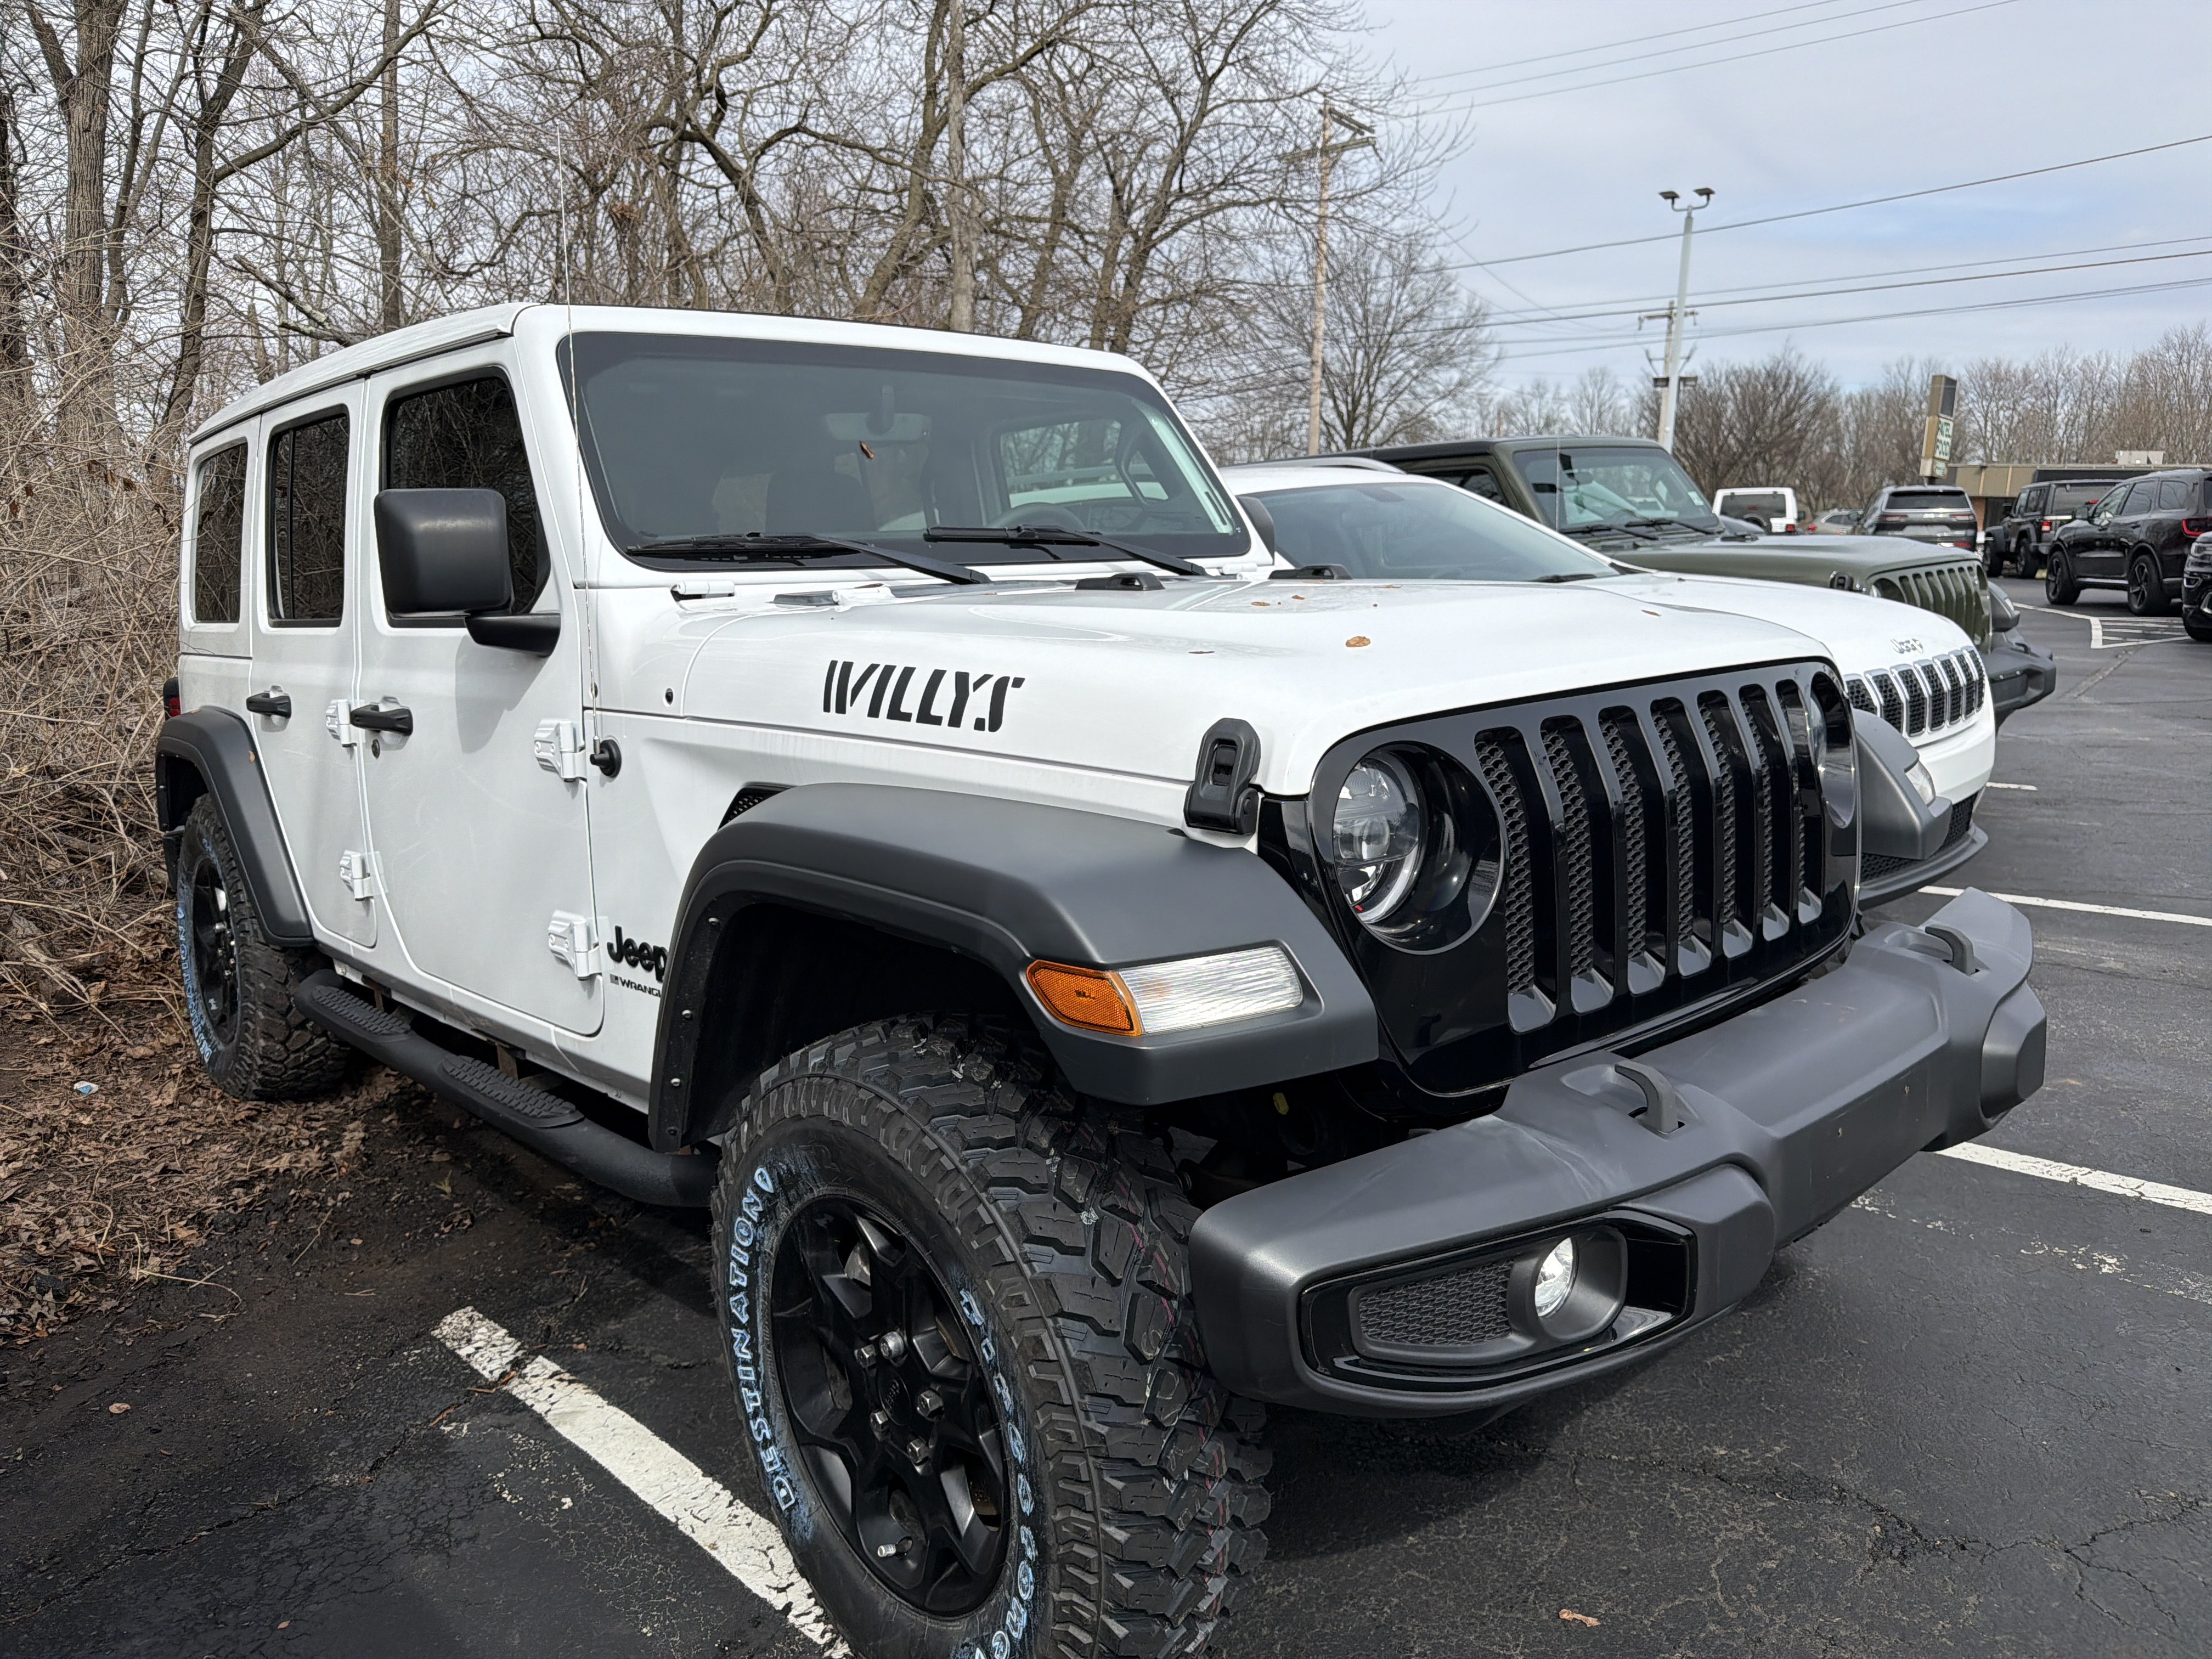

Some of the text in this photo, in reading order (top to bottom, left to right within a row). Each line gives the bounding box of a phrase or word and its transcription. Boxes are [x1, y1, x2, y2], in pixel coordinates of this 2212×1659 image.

[823, 660, 1025, 732] WILLYS
[607, 926, 667, 983] Jeep
[619, 977, 662, 998] WRANGL
[729, 1187, 795, 1510] DESTINATION
